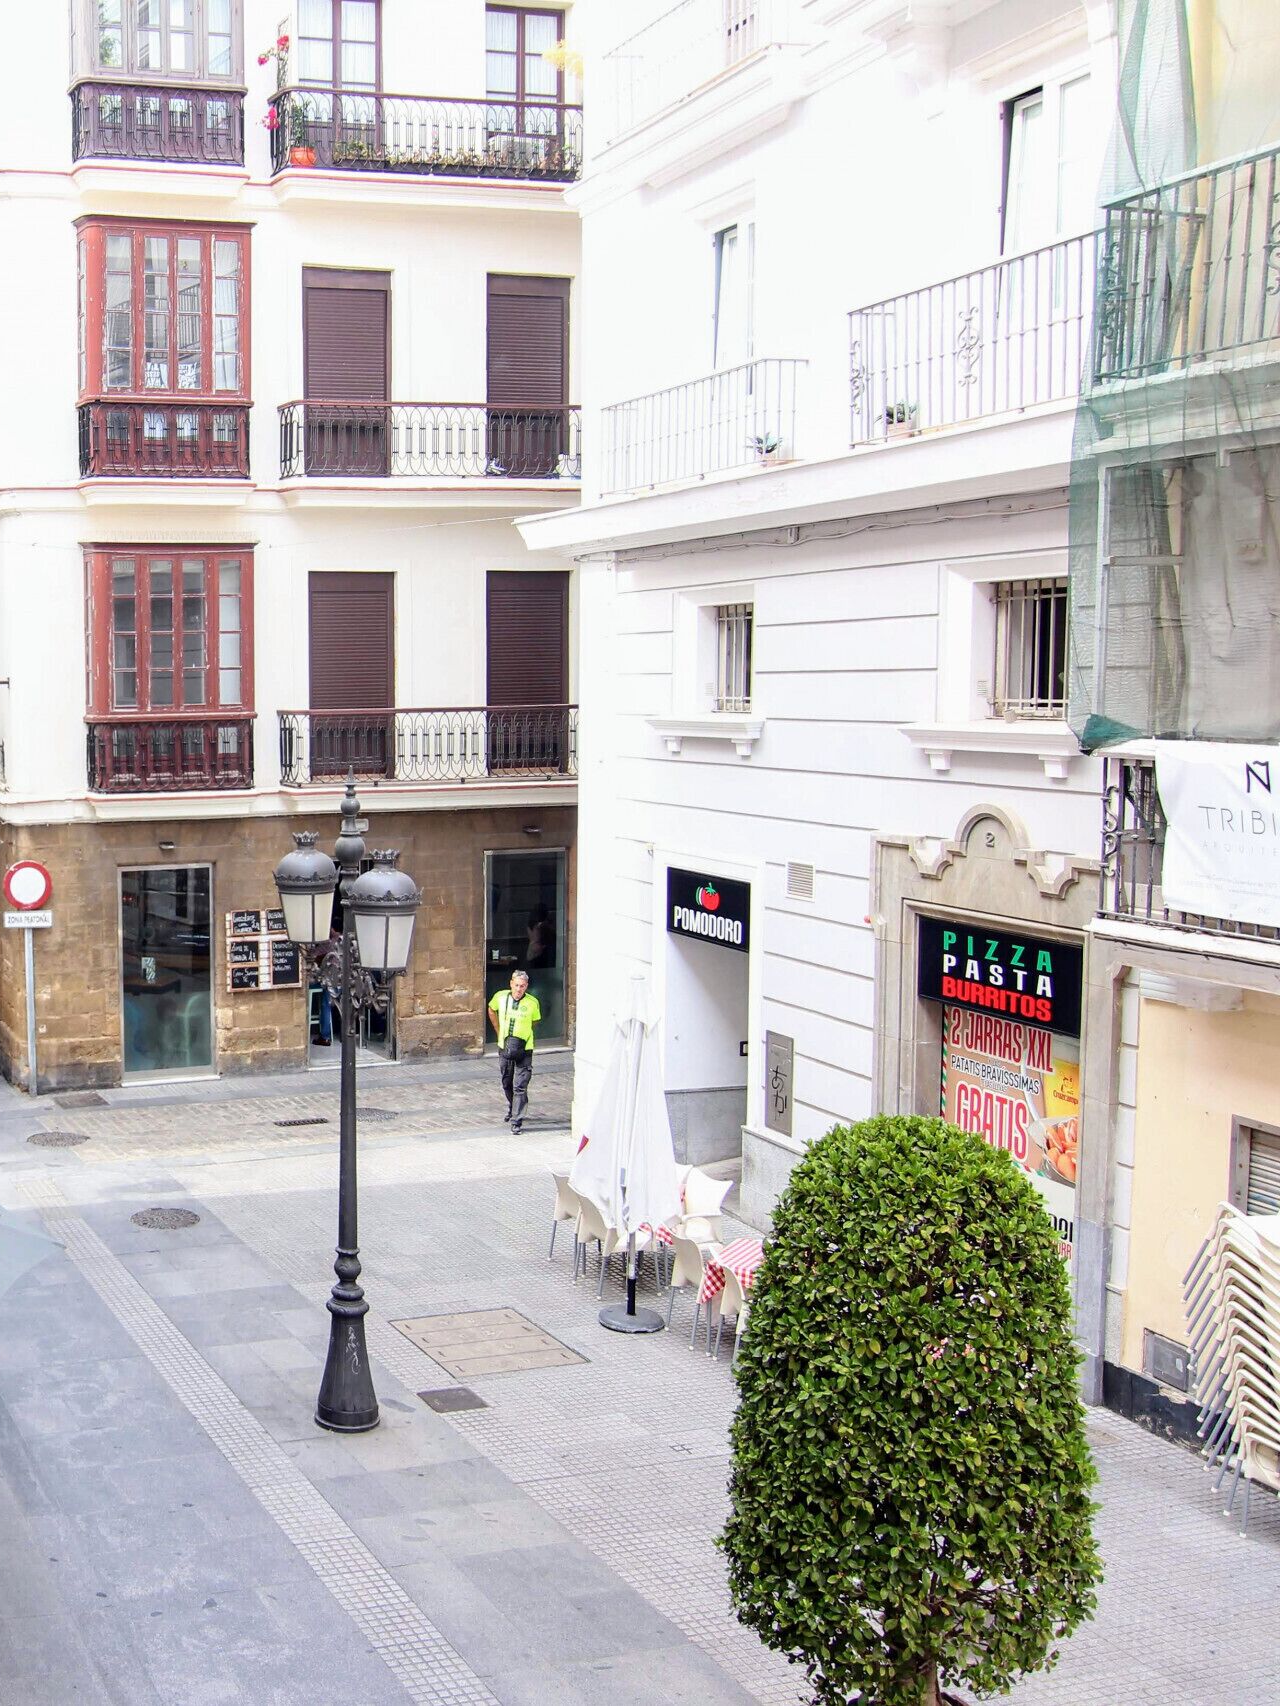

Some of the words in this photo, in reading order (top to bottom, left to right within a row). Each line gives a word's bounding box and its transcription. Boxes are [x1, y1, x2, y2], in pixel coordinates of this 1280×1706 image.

[1245, 760, 1271, 794] Ñ
[985, 832, 995, 848] 2
[673, 905, 742, 944] POMODORO
[943, 930, 1052, 973] PIZZA
[943, 953, 1052, 998] PASTA
[942, 975, 1053, 1022] BURRITOS
[951, 1008, 961, 1046] 2
[965, 1011, 1022, 1063] JARRAS
[1026, 1028, 1053, 1072] XXL
[956, 1083, 1028, 1160] GRATIS
